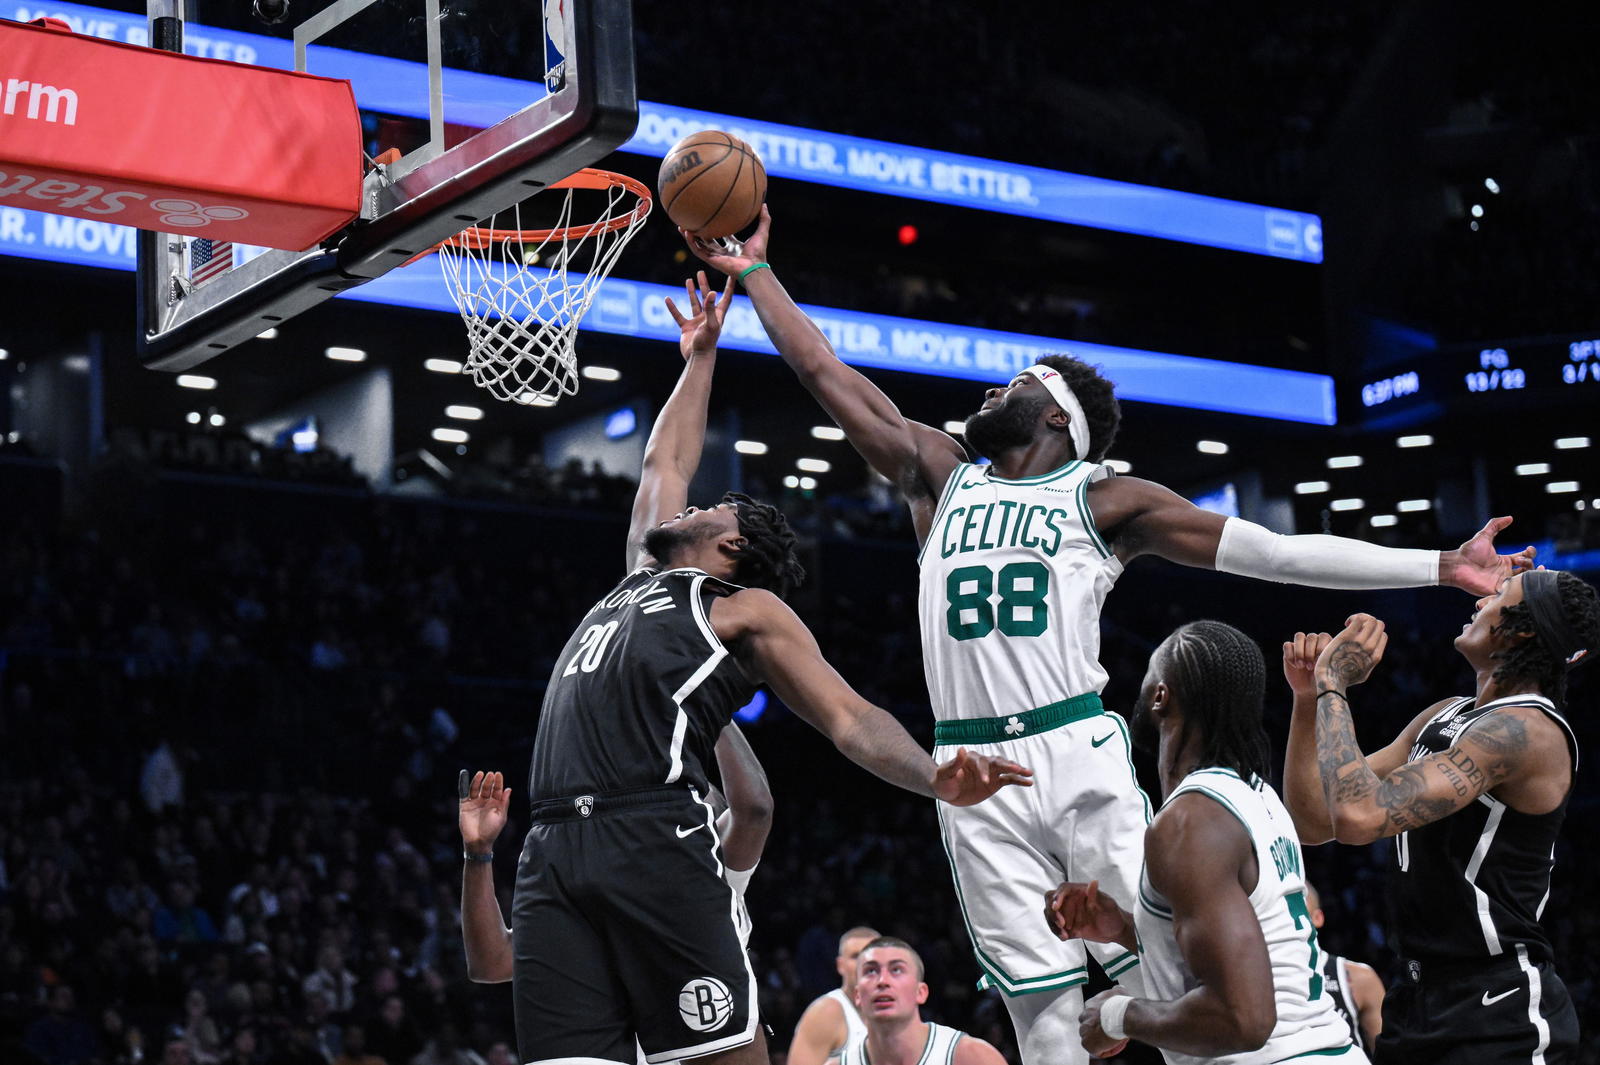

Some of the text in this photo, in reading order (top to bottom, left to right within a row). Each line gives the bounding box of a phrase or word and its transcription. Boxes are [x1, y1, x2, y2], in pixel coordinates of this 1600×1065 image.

[0, 77, 78, 126] rm
[847, 147, 927, 189] MOVE
[0, 171, 148, 214] Stat
[891, 328, 971, 367] MOVE
[941, 500, 1067, 559] CELTICS
[946, 562, 1049, 641] 88
[563, 620, 619, 678] 20
[576, 797, 593, 807] NETS
[1284, 891, 1323, 1002] 7
[694, 985, 717, 1026] B
